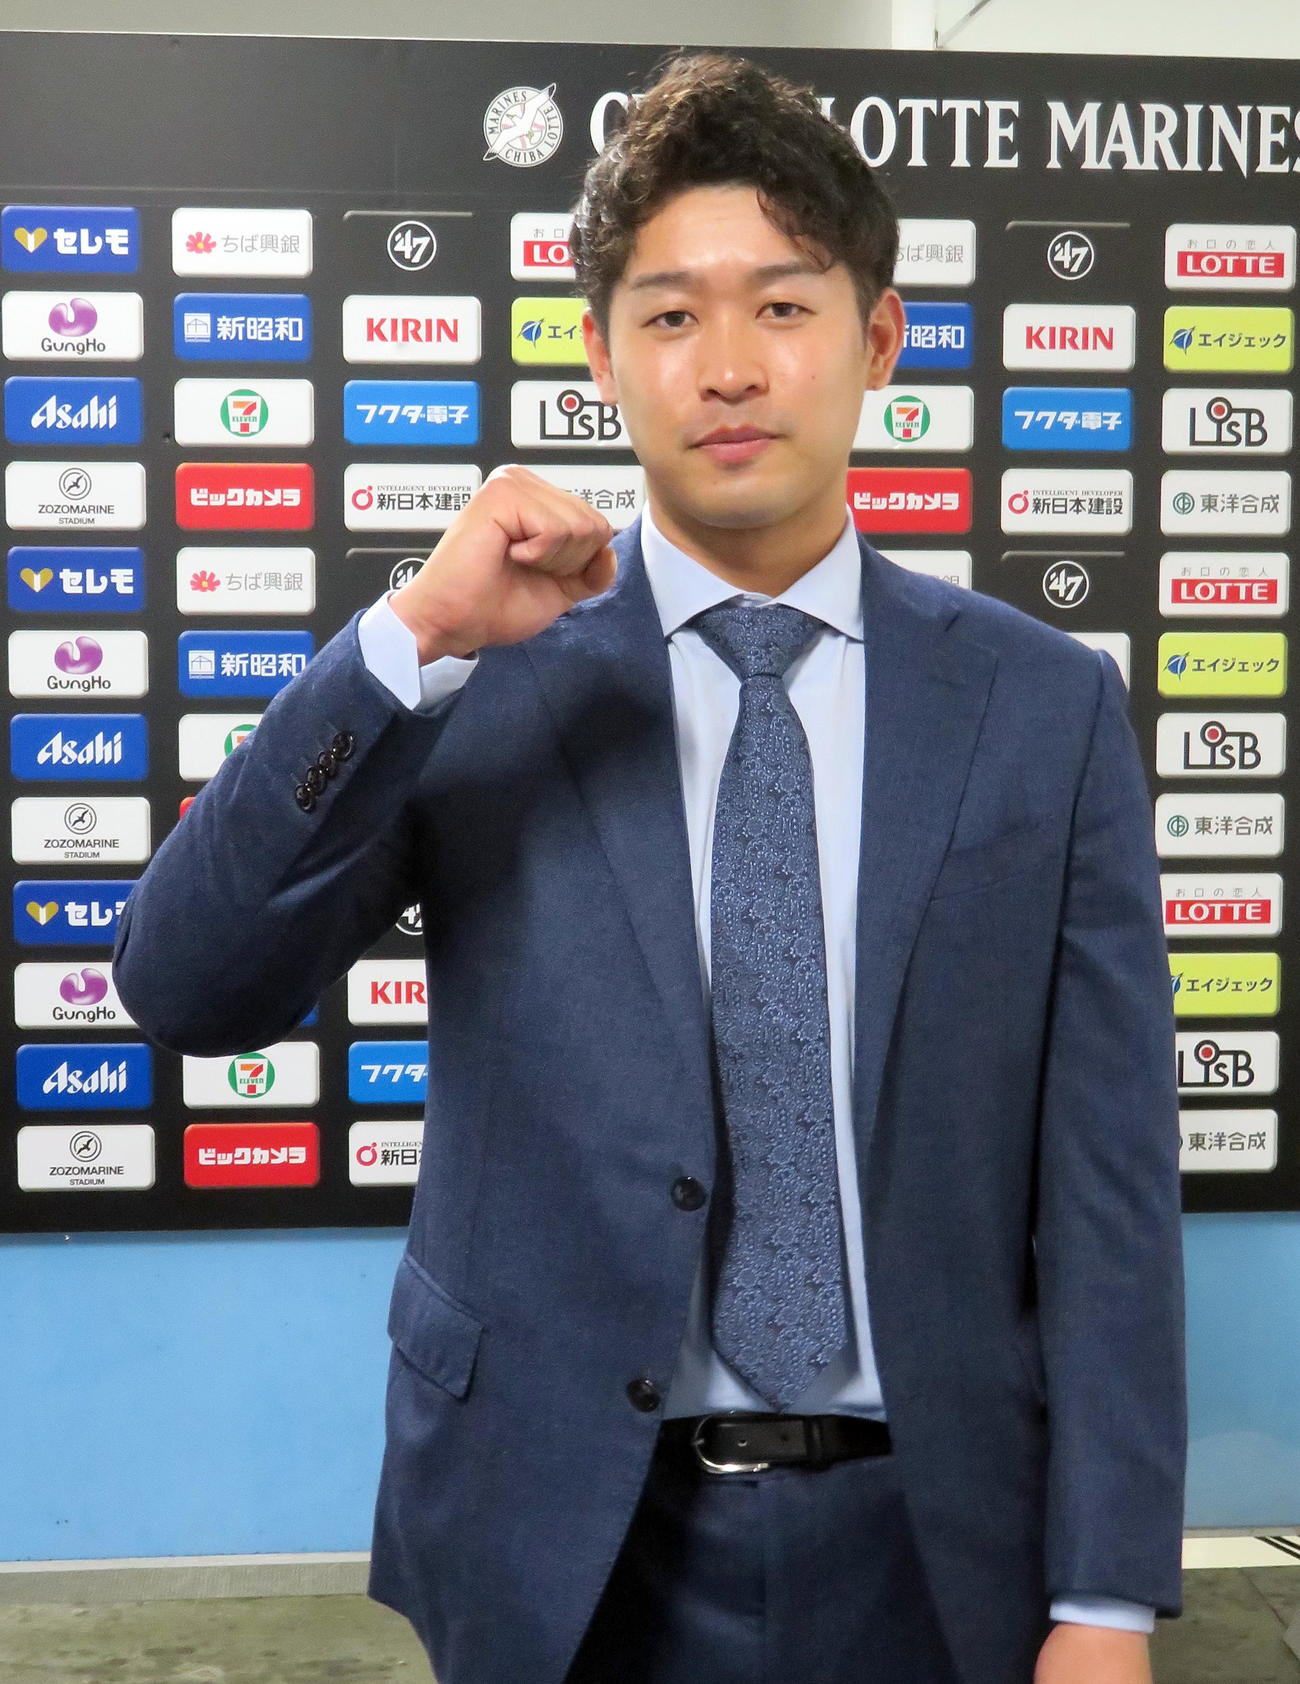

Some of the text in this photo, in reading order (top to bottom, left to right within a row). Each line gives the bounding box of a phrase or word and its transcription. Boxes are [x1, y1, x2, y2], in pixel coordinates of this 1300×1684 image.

[488, 91, 527, 134] MARINES
[506, 105, 560, 163] CHIBA LOTTE
[818, 96, 1019, 168] OTTE
[53, 228, 129, 255] セレモ
[221, 234, 300, 254] ちば興銀
[1186, 255, 1275, 275] LOTTE
[216, 316, 303, 341] 新昭和
[366, 318, 458, 342] KIRIN
[1025, 326, 1114, 350] KIRIN
[41, 338, 106, 355] GungHo
[1198, 332, 1287, 348] エイジェック
[31, 394, 117, 430] Asahi
[356, 404, 469, 424] フクダ電子
[1014, 410, 1122, 431] フクダ電子
[190, 488, 301, 507] ビックカメラ
[853, 491, 959, 511] ビックカメラ
[1081, 489, 1123, 497] DEVELOPER
[38, 504, 115, 515] ZOZOMARINE
[1032, 497, 1123, 515] 新日本建設
[1200, 493, 1280, 514] 東洋合成
[58, 517, 95, 525] STADIUM
[59, 568, 134, 594] セレモ
[225, 572, 303, 592] ちば興銀
[1180, 582, 1268, 601] LOTTE
[221, 652, 306, 677] 新昭和
[1191, 657, 1280, 673] エイジェック
[47, 675, 111, 692] GungHo
[37, 731, 122, 765] Asahi
[1194, 816, 1273, 836] 東洋合成
[44, 839, 119, 849] ZOZOMARINE
[64, 851, 100, 859] STADIUM
[1174, 903, 1262, 921] LOTTE
[1186, 977, 1273, 993] エイジェック
[53, 1006, 116, 1023] GungHo
[42, 1060, 127, 1095] Asahi
[1188, 1131, 1267, 1152] 東洋合成
[198, 1146, 306, 1166] ビックカメラ
[49, 1166, 125, 1176] ZOZOMARINE
[69, 1178, 105, 1186] STADIUM
